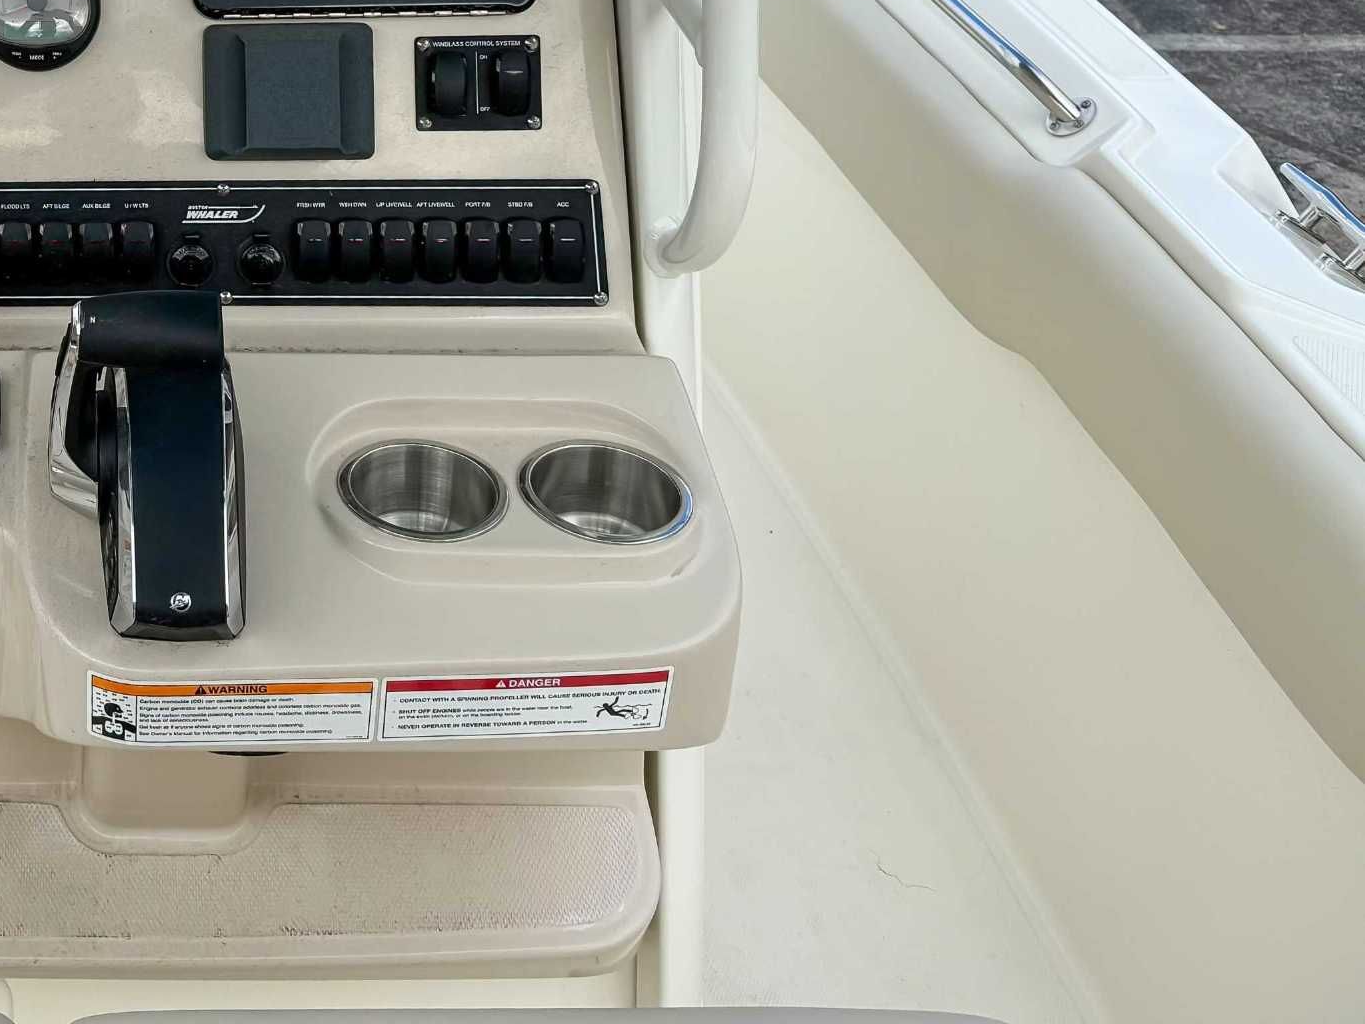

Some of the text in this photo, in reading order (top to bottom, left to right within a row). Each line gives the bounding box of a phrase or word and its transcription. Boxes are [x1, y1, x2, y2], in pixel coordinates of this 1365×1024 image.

[495, 39, 521, 47] SYSTEM
[186, 210, 239, 219] WHALER
[509, 678, 561, 688] DANGER
[208, 685, 268, 694] WARNING
